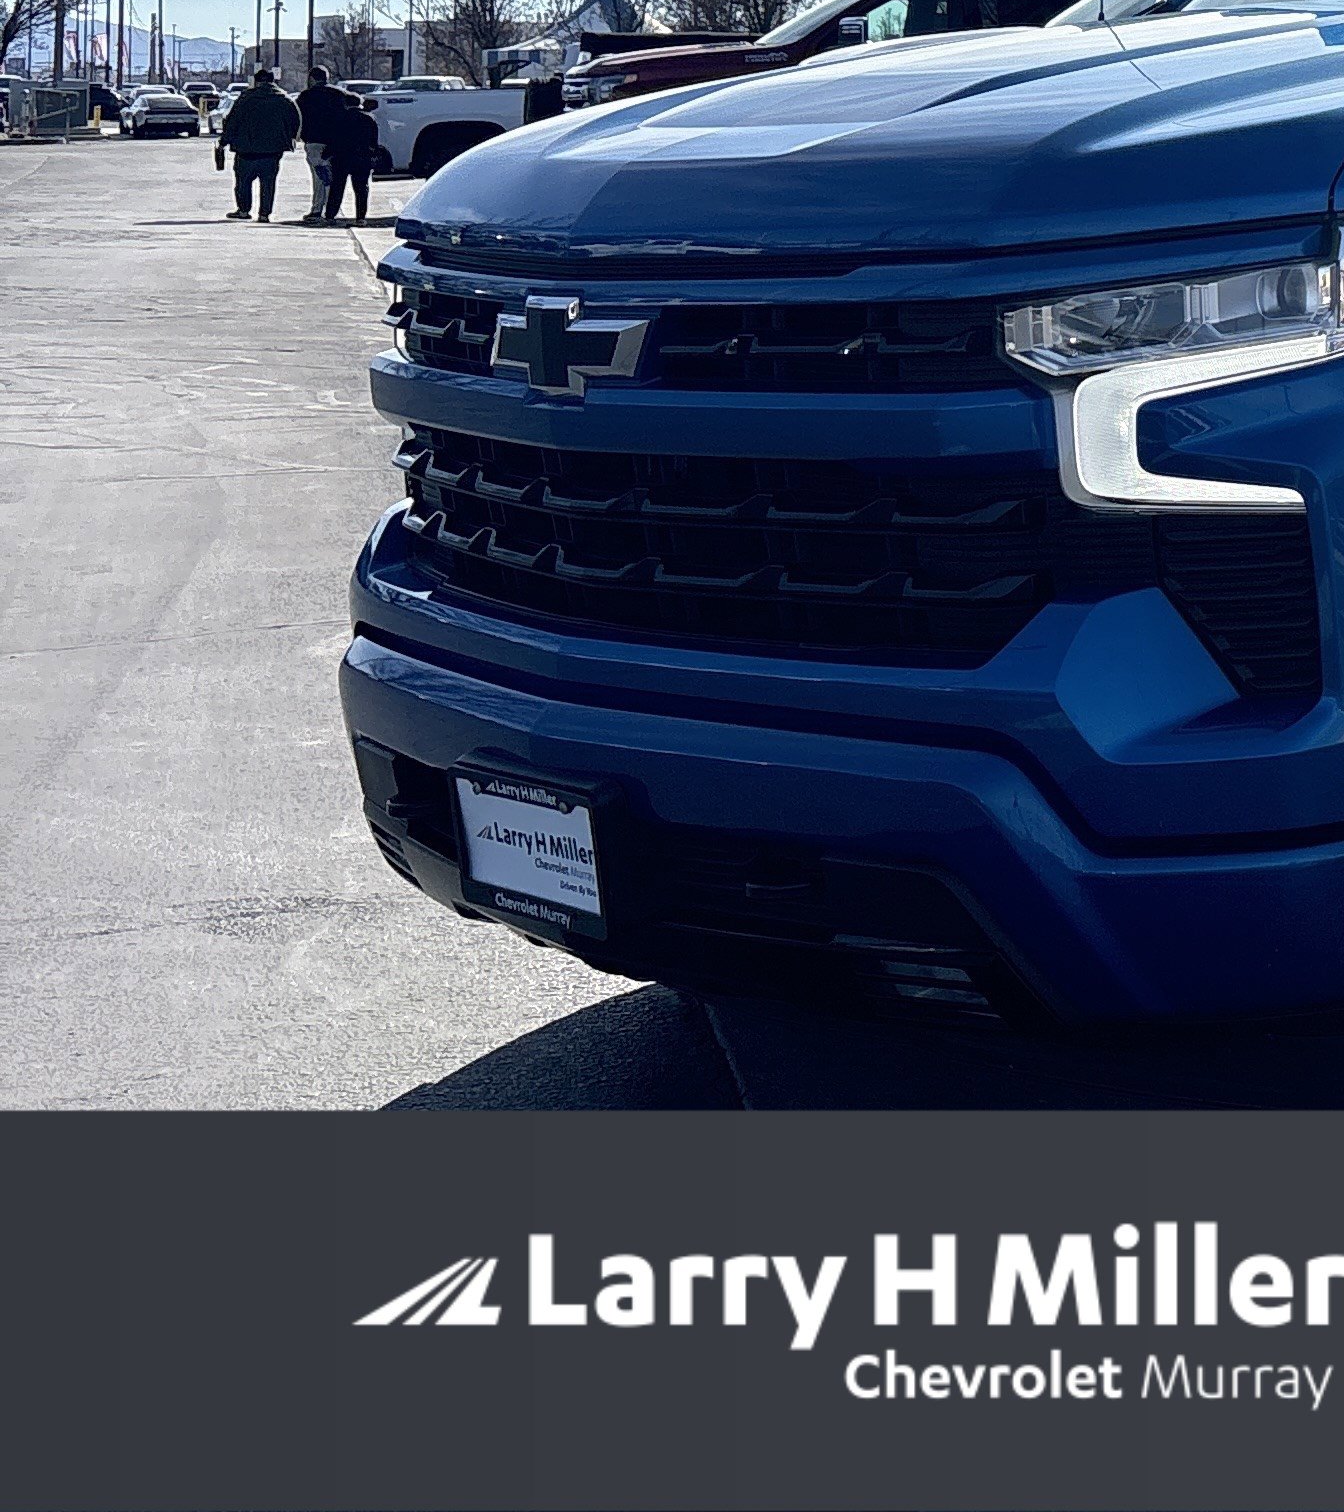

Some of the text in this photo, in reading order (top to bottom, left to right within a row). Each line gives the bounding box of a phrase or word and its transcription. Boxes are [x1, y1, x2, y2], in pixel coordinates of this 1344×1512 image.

[495, 780, 522, 800] Larry
[530, 787, 557, 806] Miller
[494, 821, 594, 865] Larry H Miller
[534, 857, 570, 876] Chevrolet
[494, 891, 571, 929] Chevrolet Murray
